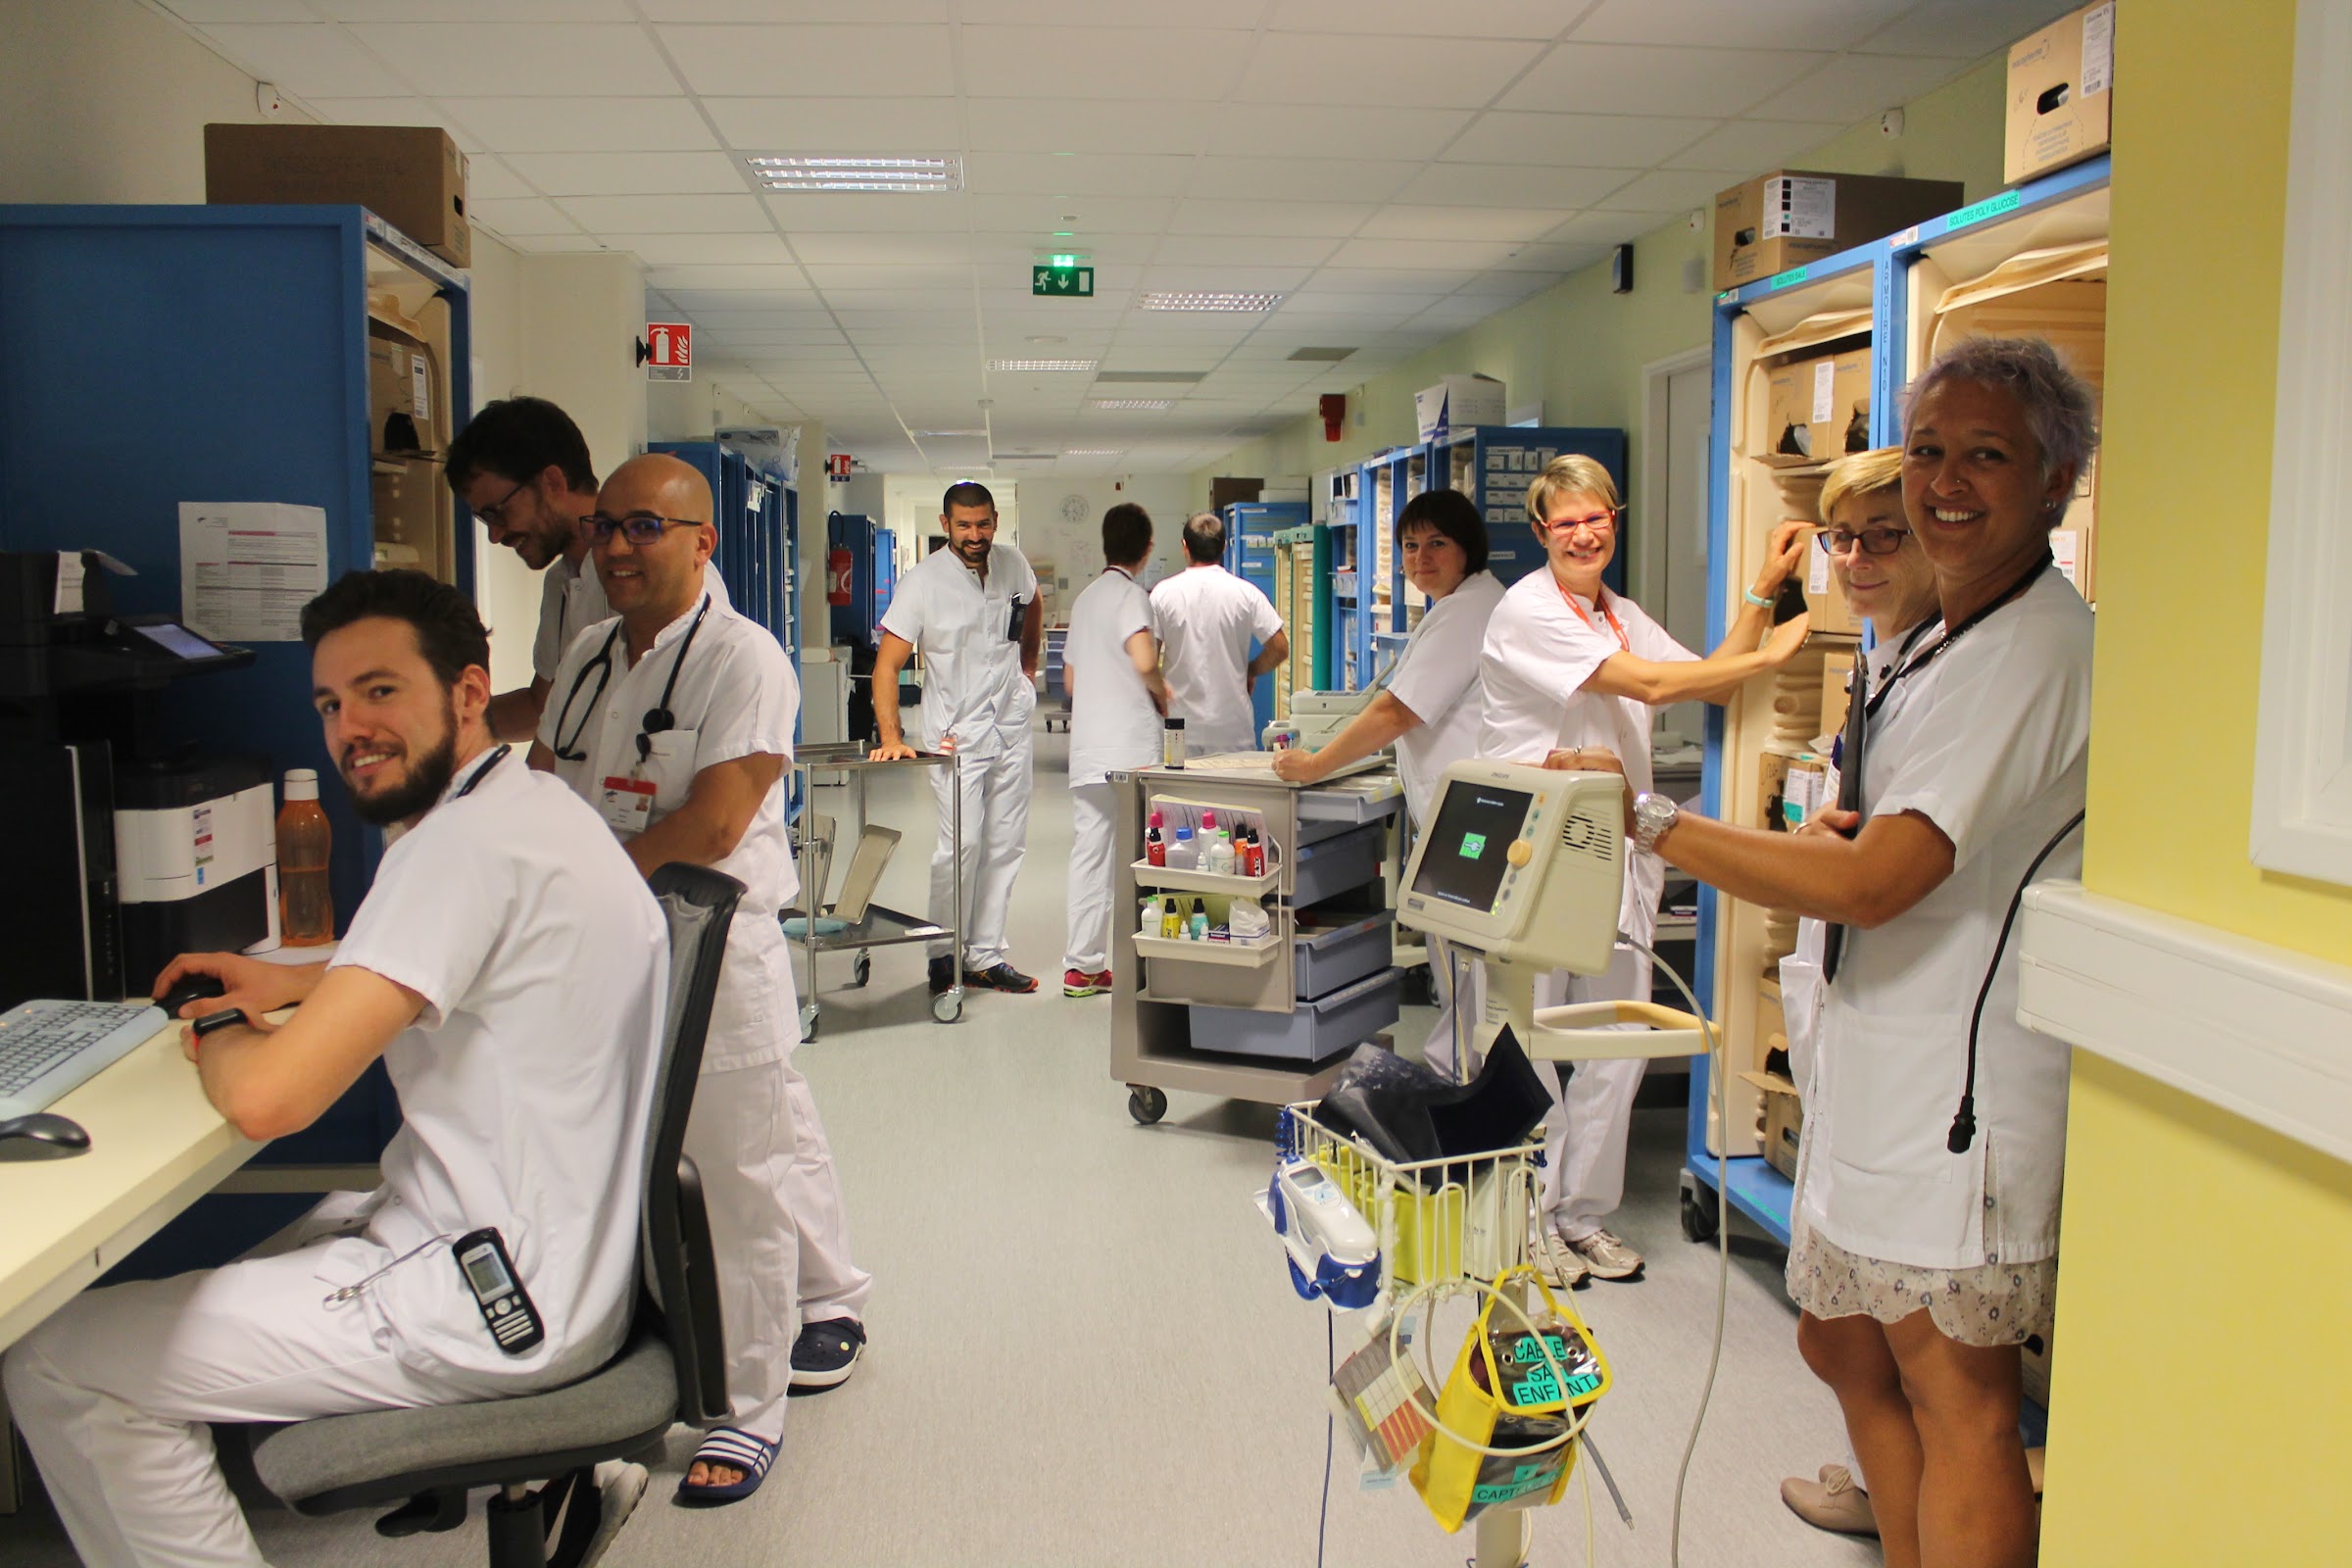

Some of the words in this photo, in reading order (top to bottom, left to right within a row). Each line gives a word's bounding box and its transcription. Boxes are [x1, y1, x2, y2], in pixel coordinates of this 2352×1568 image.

[1949, 209, 1974, 227] SOLUTES
[1975, 204, 1990, 220] POLY
[1990, 194, 2019, 213] GLUCOSE
[1513, 1341, 1566, 1361] CABE
